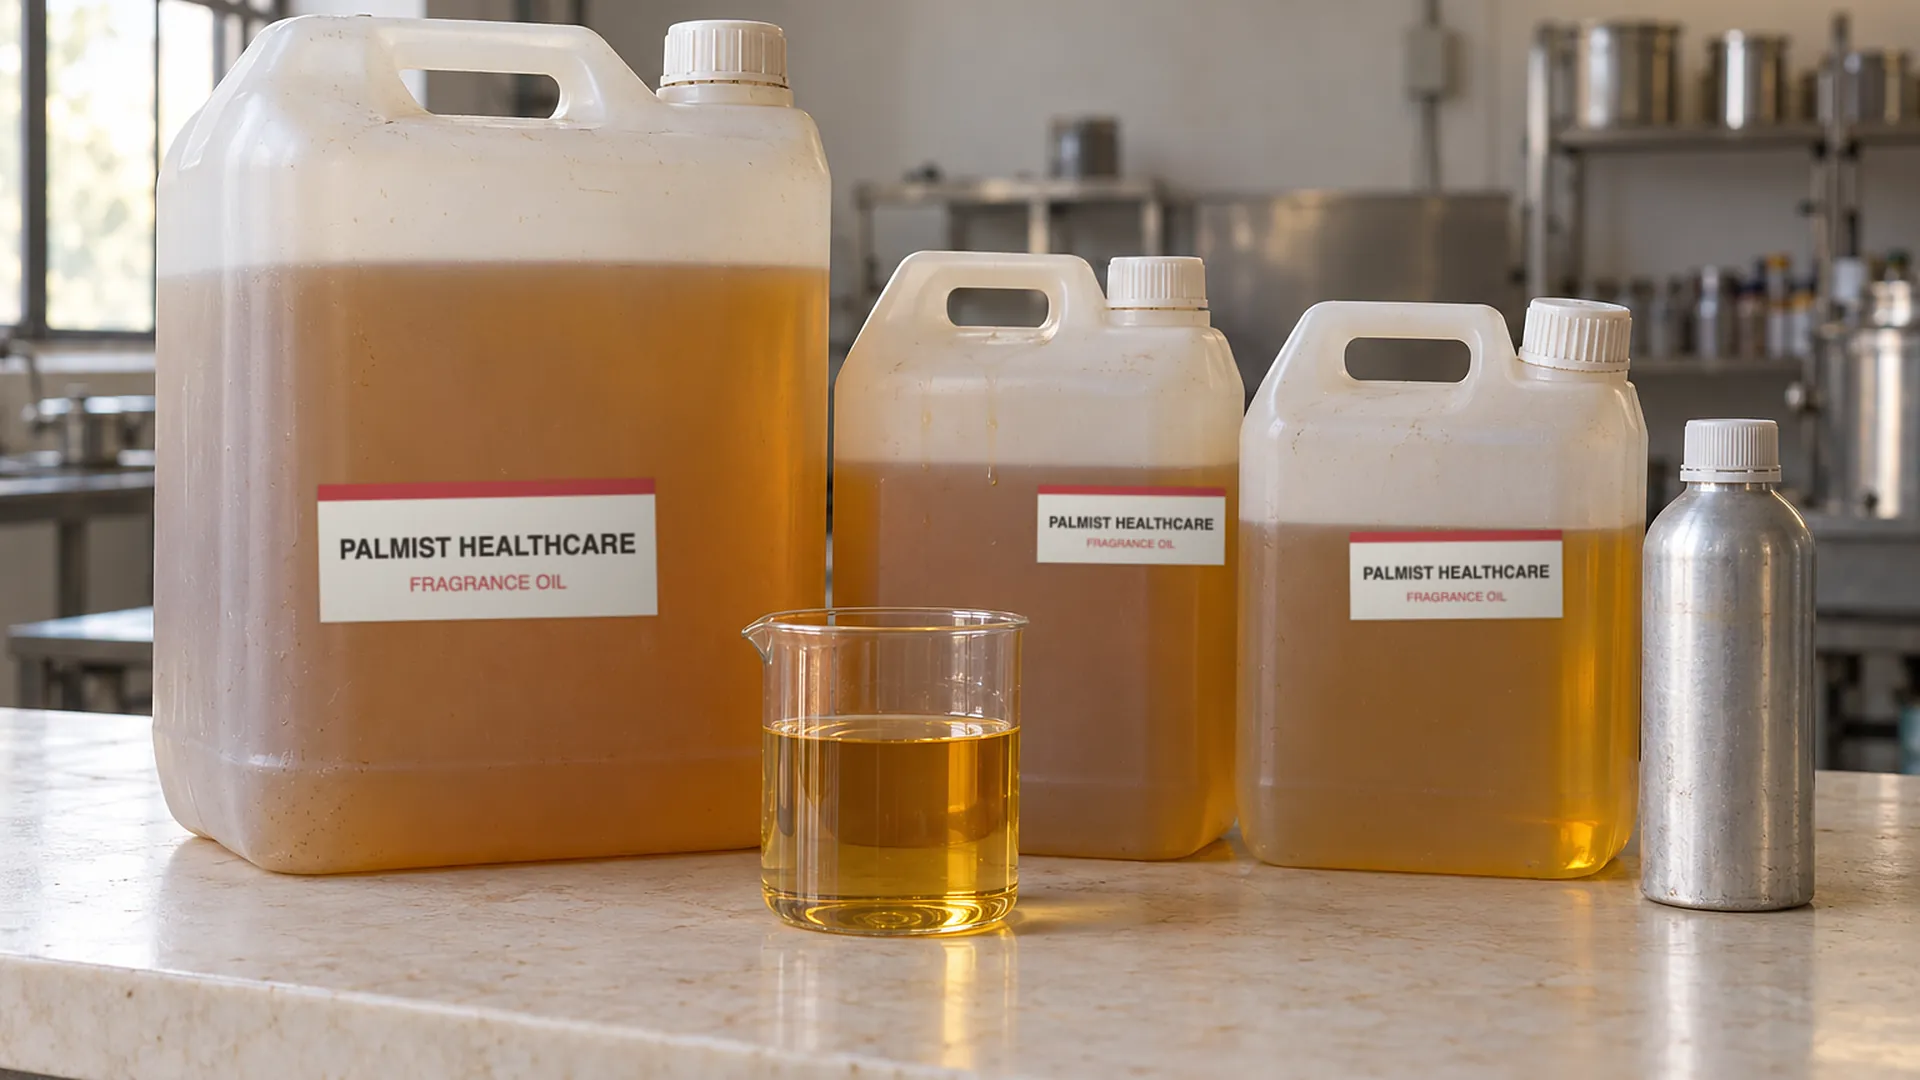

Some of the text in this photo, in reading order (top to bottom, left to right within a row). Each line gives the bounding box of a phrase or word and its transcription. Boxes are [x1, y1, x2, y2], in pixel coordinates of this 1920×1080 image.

[1049, 515, 1214, 531] PALMIST HEALTHCARE
[340, 532, 636, 560] PALMIST HEALTHCARE
[1086, 538, 1176, 549] FRAGRANCE OIL
[1363, 564, 1550, 580] PALMIST HEALTHCARE
[409, 573, 567, 593] FRAGRANCE OIL
[1406, 591, 1507, 603] FRAGRANCE OIL
